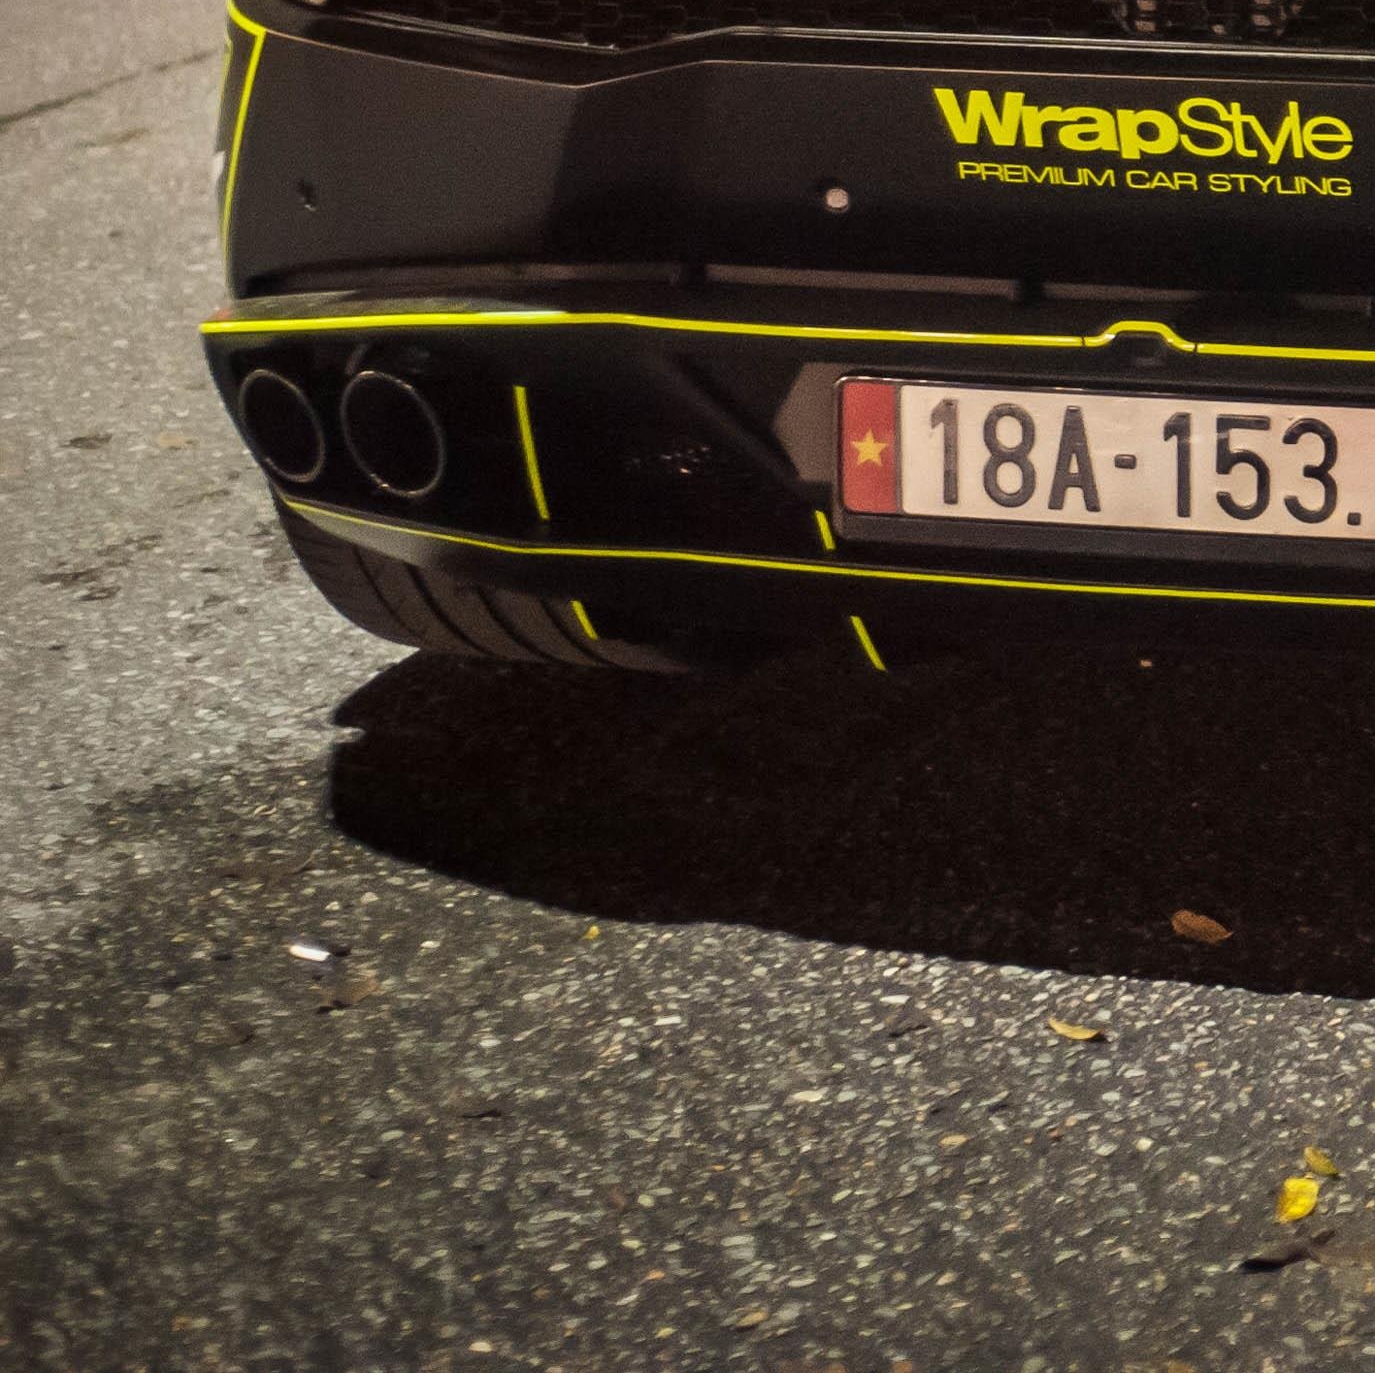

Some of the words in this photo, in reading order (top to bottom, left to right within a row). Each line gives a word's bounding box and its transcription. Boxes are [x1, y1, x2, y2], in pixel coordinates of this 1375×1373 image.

[933, 86, 1354, 165] WrapStyle
[957, 160, 1117, 189] PREMIUM
[1125, 169, 1199, 191] CAR
[1208, 175, 1353, 198] STYLING
